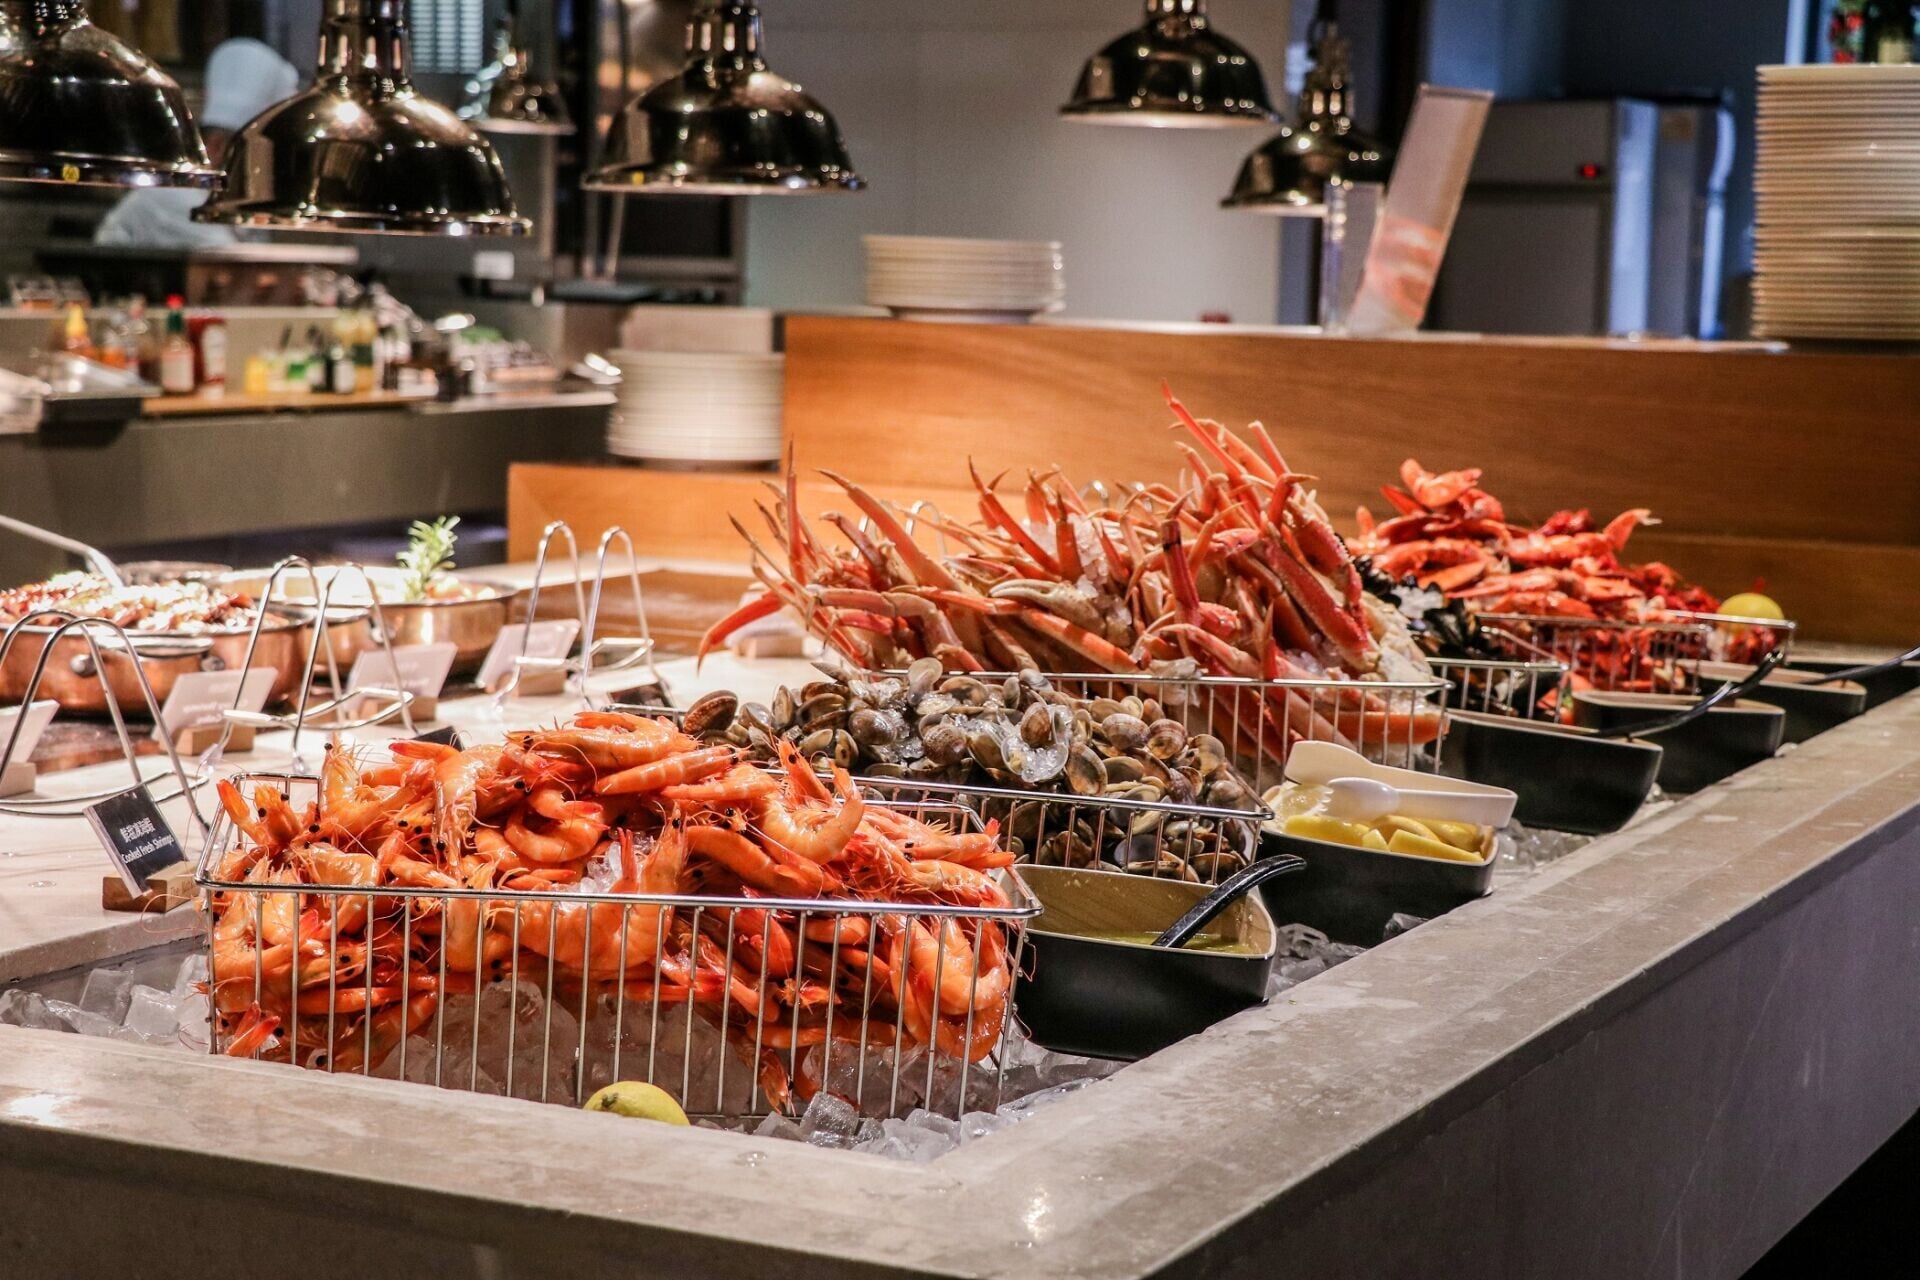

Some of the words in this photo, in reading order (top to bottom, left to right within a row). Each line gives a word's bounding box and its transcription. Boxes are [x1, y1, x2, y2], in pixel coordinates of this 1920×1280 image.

[121, 846, 142, 863] Cooked
[139, 841, 156, 856] Fresh
[152, 834, 174, 849] Shrimps
